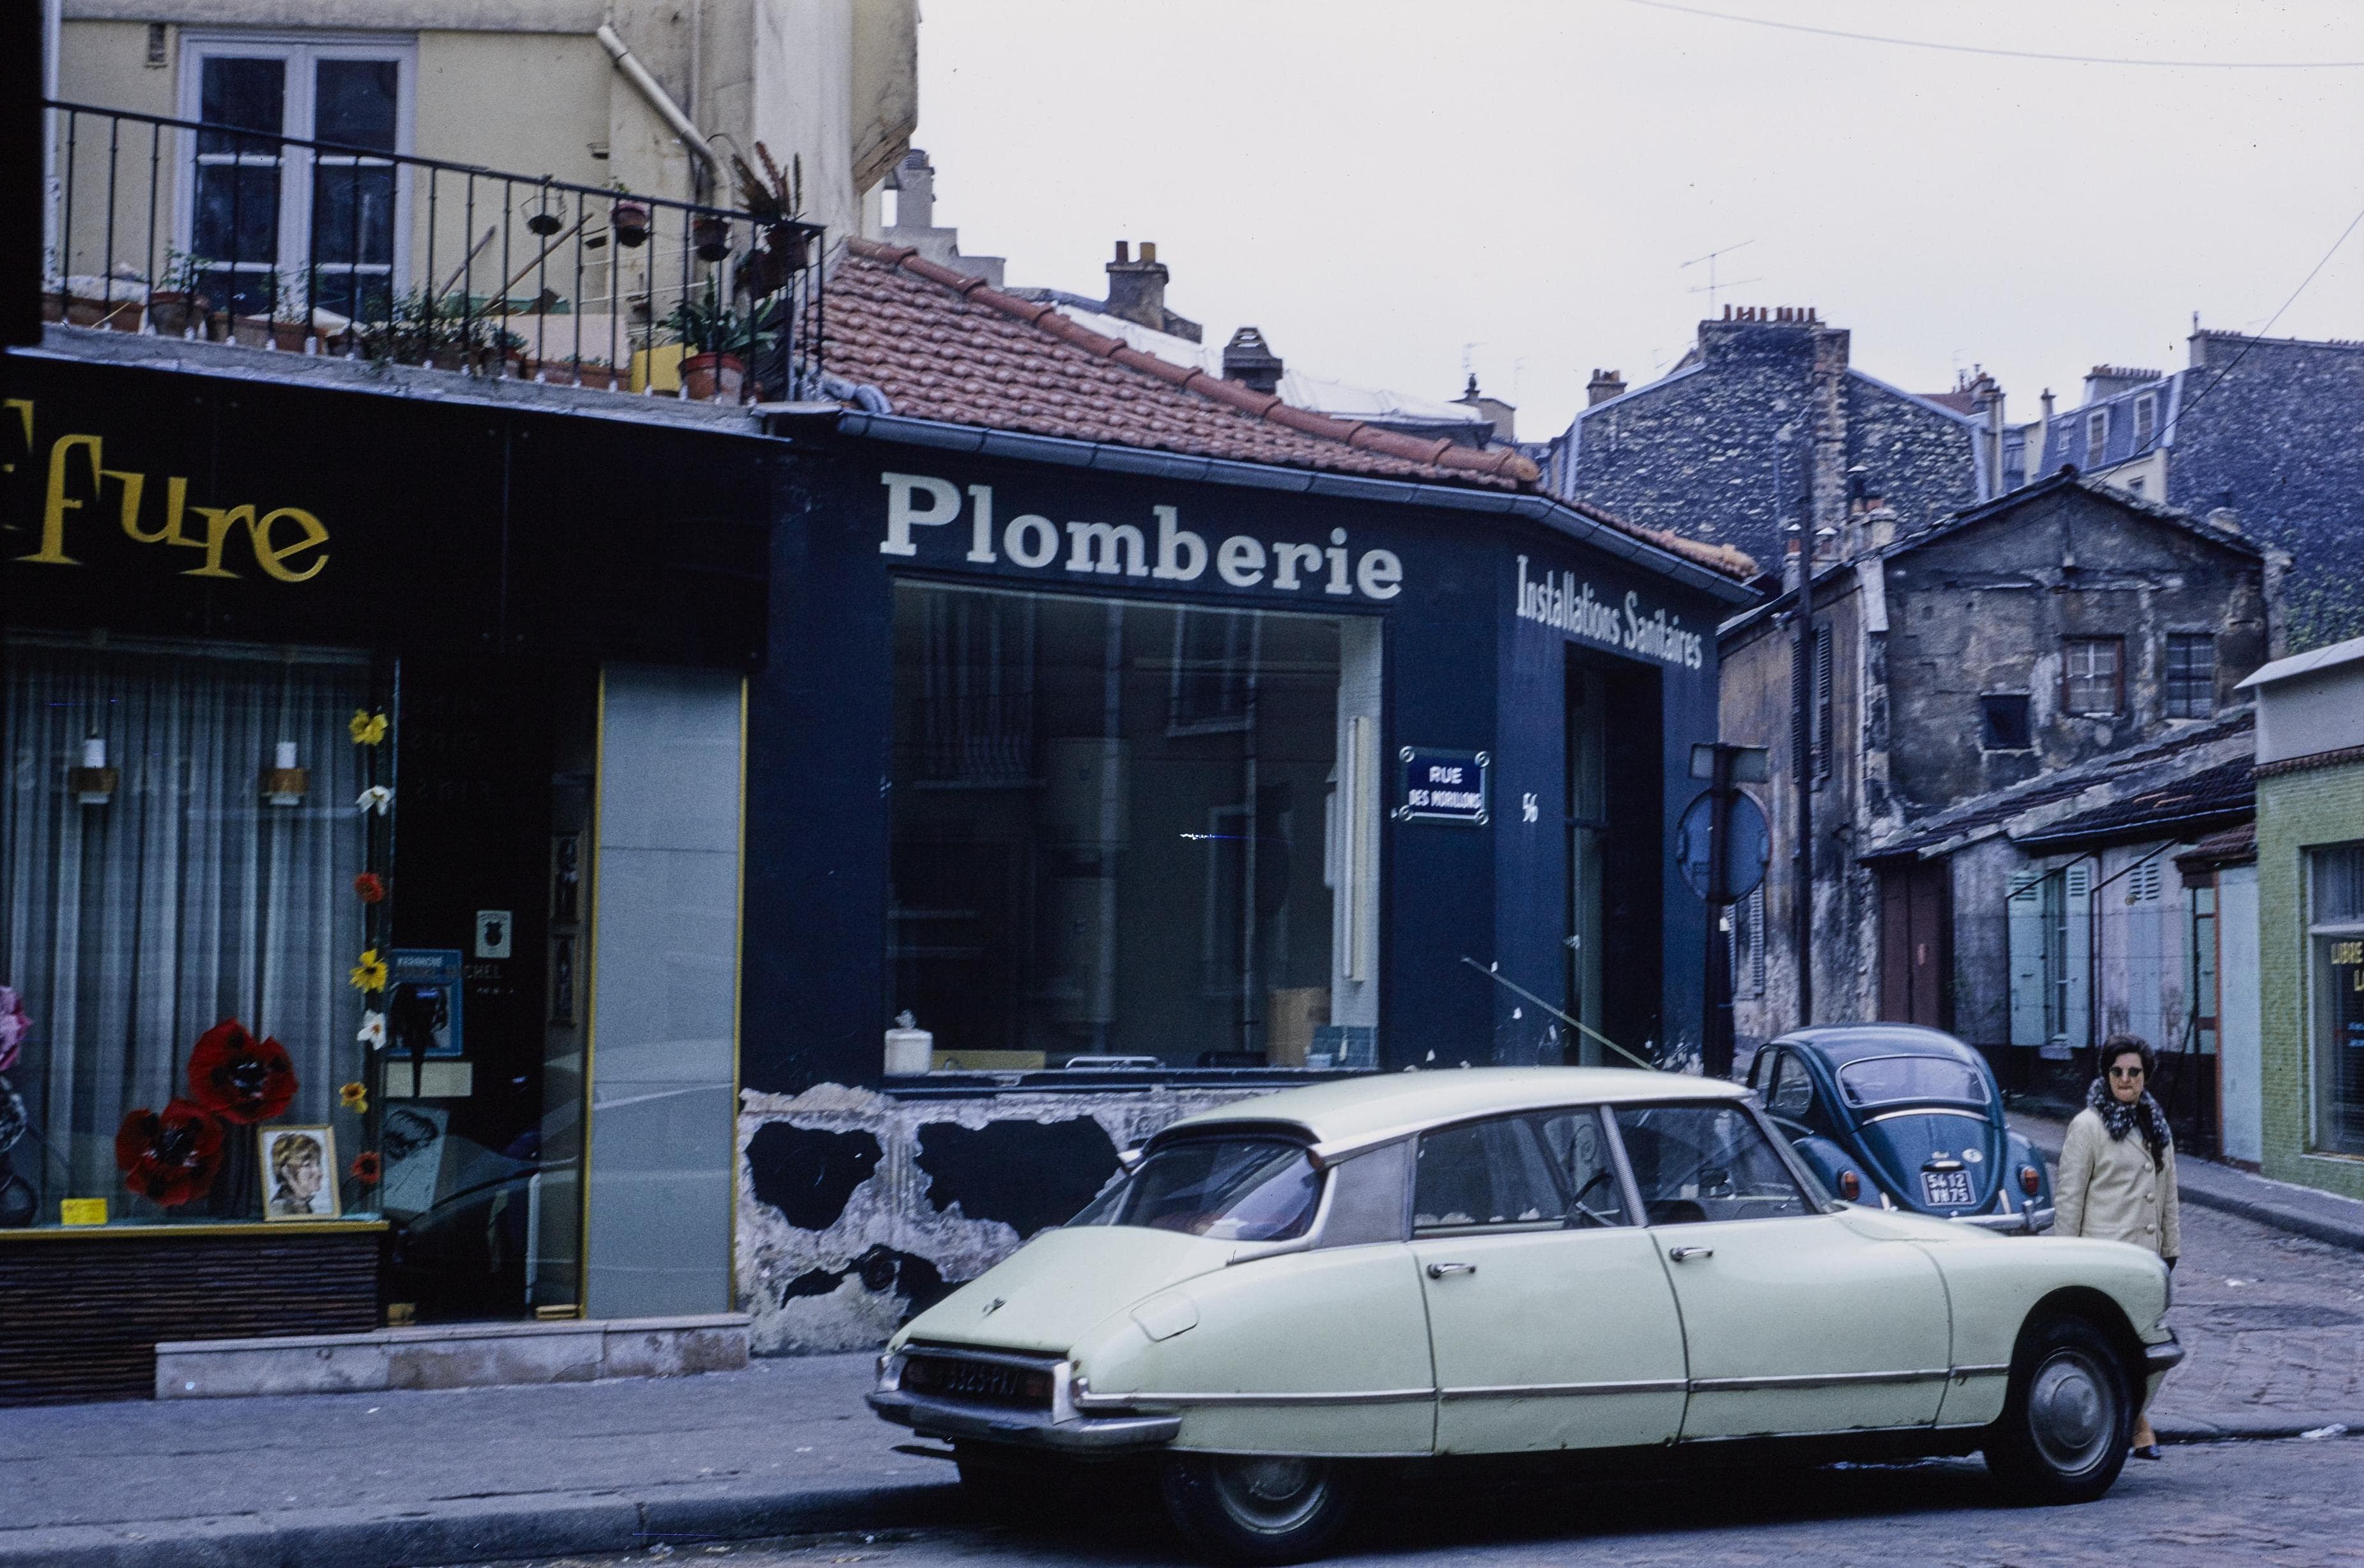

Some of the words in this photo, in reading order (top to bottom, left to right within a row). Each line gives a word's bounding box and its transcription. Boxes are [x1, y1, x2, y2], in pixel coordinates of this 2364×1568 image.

[879, 472, 1403, 601] Plomberie
[1516, 554, 1620, 645] Installations
[1623, 590, 1703, 669] Sanitaires
[1409, 789, 1429, 806] DES
[1429, 765, 1463, 784] RUE
